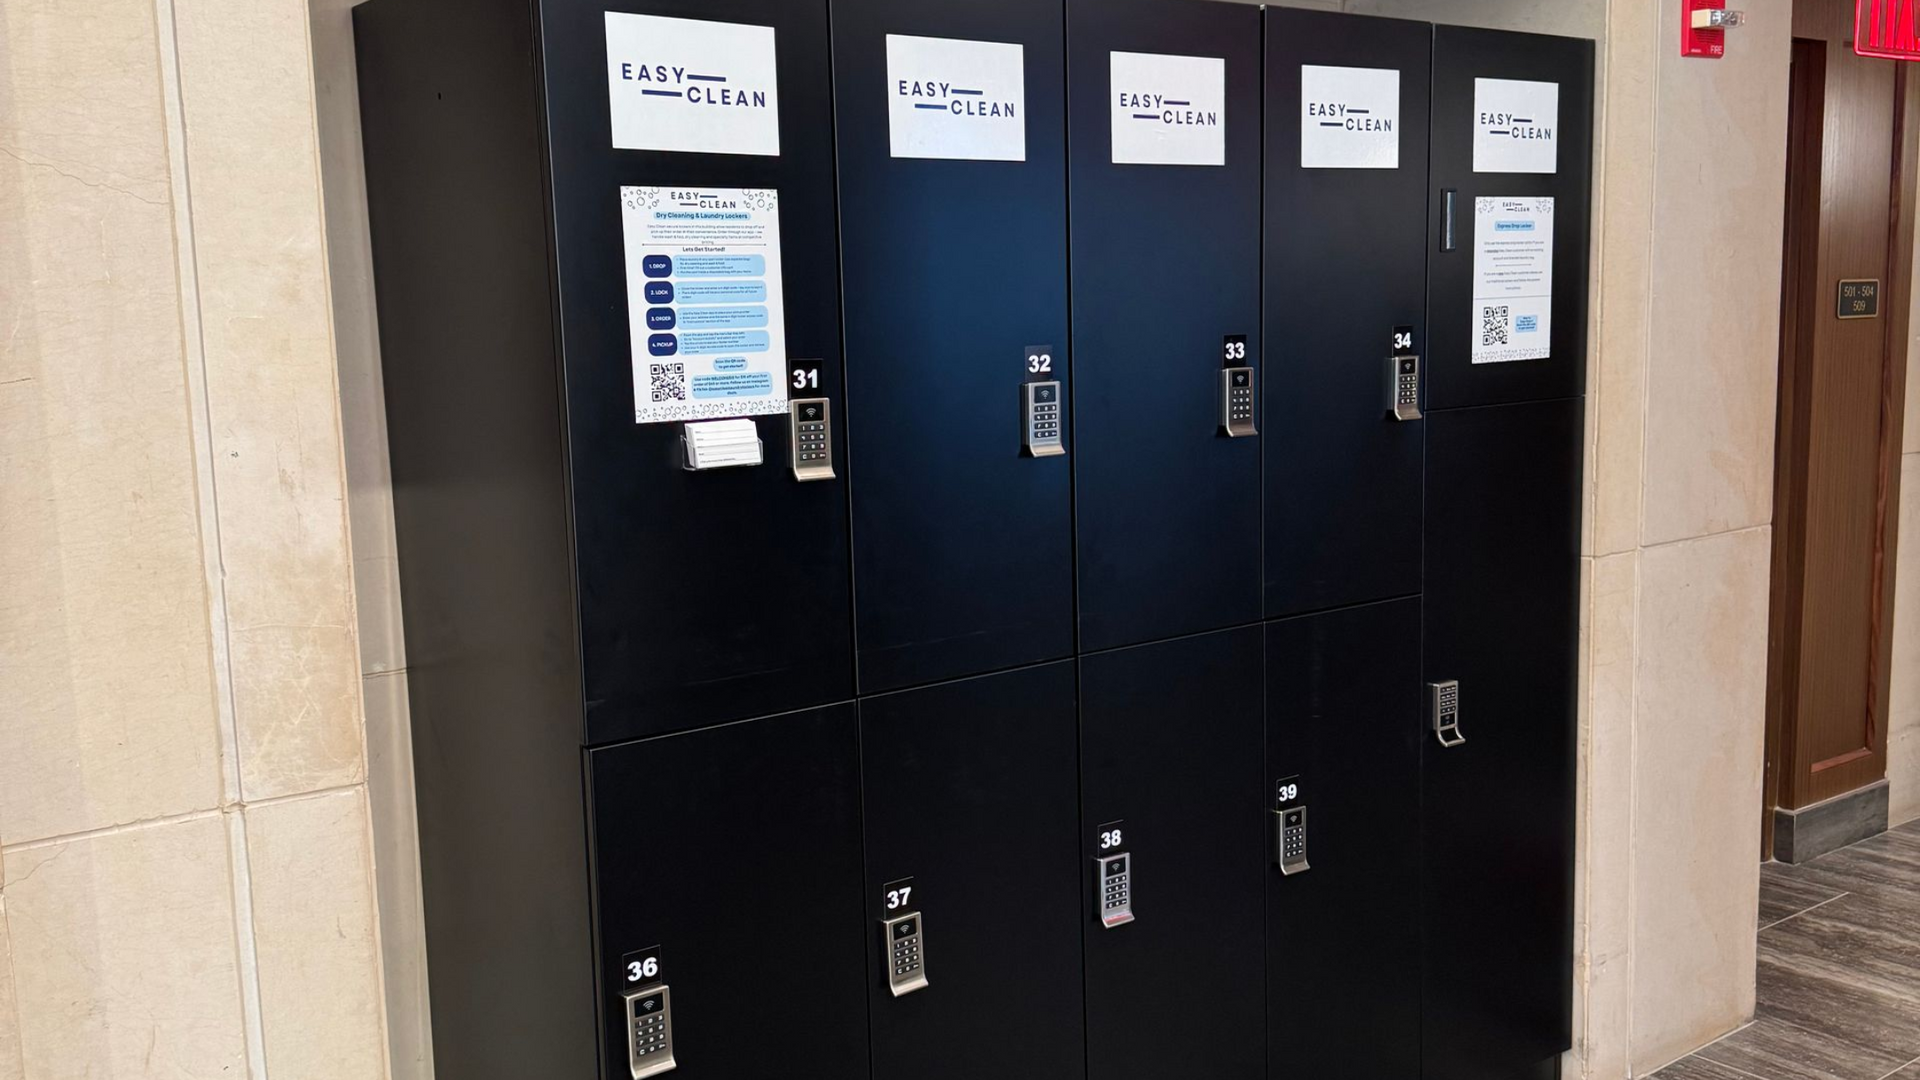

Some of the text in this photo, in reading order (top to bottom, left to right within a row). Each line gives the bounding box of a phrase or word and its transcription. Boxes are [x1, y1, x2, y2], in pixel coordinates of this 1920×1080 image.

[1710, 45, 1722, 54] FIRE
[622, 63, 685, 83] EASY
[899, 80, 950, 98] EASY
[687, 87, 765, 107] CLEAN
[1121, 93, 1163, 108] EASY
[951, 100, 1014, 117] CLEAN
[1310, 103, 1346, 116] EASY
[1163, 111, 1215, 125] CLEAN
[1346, 119, 1391, 131] CLEAN
[1481, 113, 1512, 125] EASY
[1512, 127, 1550, 139] CLEAN
[671, 192, 699, 200] EASY
[656, 212, 667, 220] Dry
[667, 212, 695, 221] Cleaning
[701, 212, 724, 221] Laundry
[1844, 286, 1856, 297] 501
[1861, 285, 1874, 297] 504
[1853, 300, 1866, 311] 509
[1395, 333, 1411, 348] 34
[1226, 343, 1244, 359] 33
[1029, 355, 1050, 372] 32
[794, 369, 817, 388] 31
[1279, 784, 1296, 801] 39
[1101, 830, 1121, 848] 38
[888, 887, 911, 908] 37
[628, 957, 657, 981] 36
